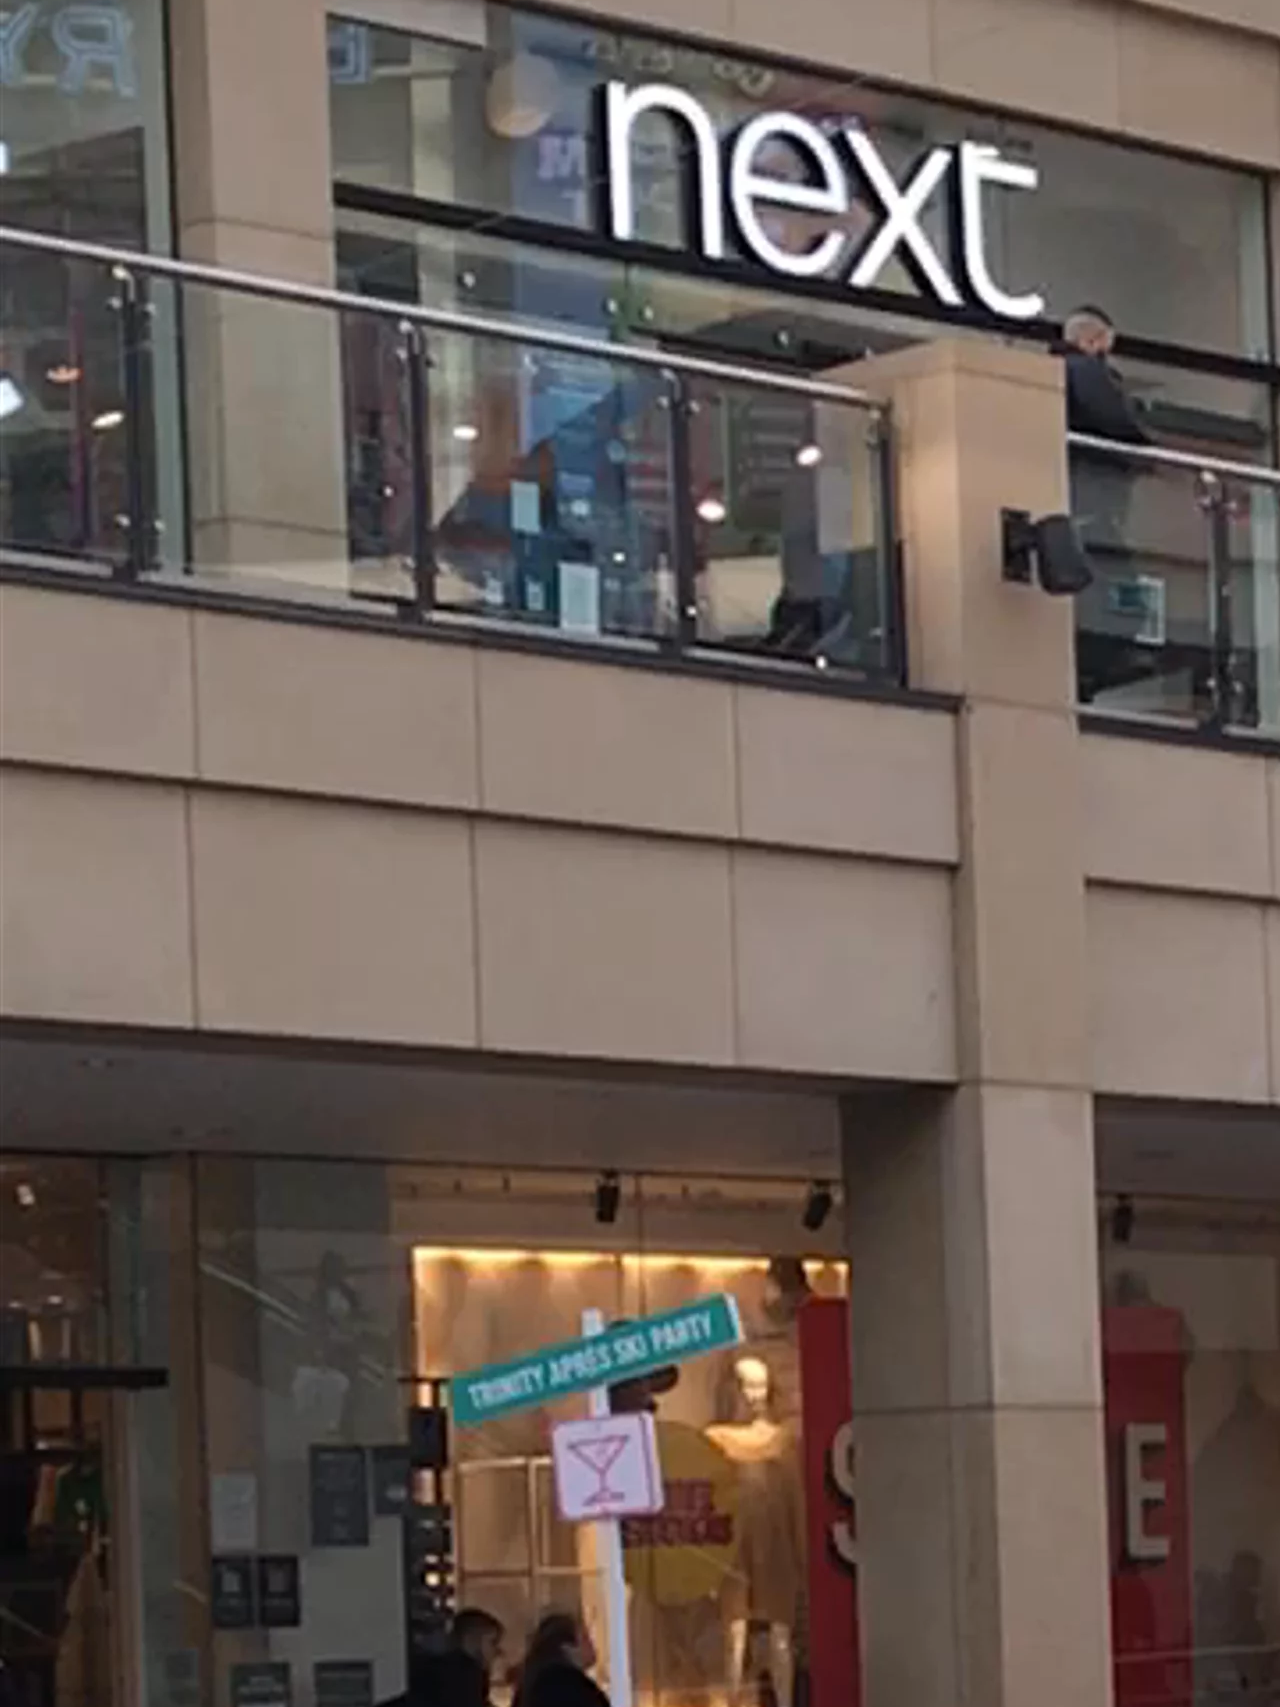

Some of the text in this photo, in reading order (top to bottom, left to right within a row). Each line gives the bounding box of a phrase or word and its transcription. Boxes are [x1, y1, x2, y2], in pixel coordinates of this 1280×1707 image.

[606, 80, 1044, 318] next
[468, 1364, 544, 1410] TRINITY
[613, 1335, 648, 1363] SKI
[651, 1310, 712, 1353] PARTY
